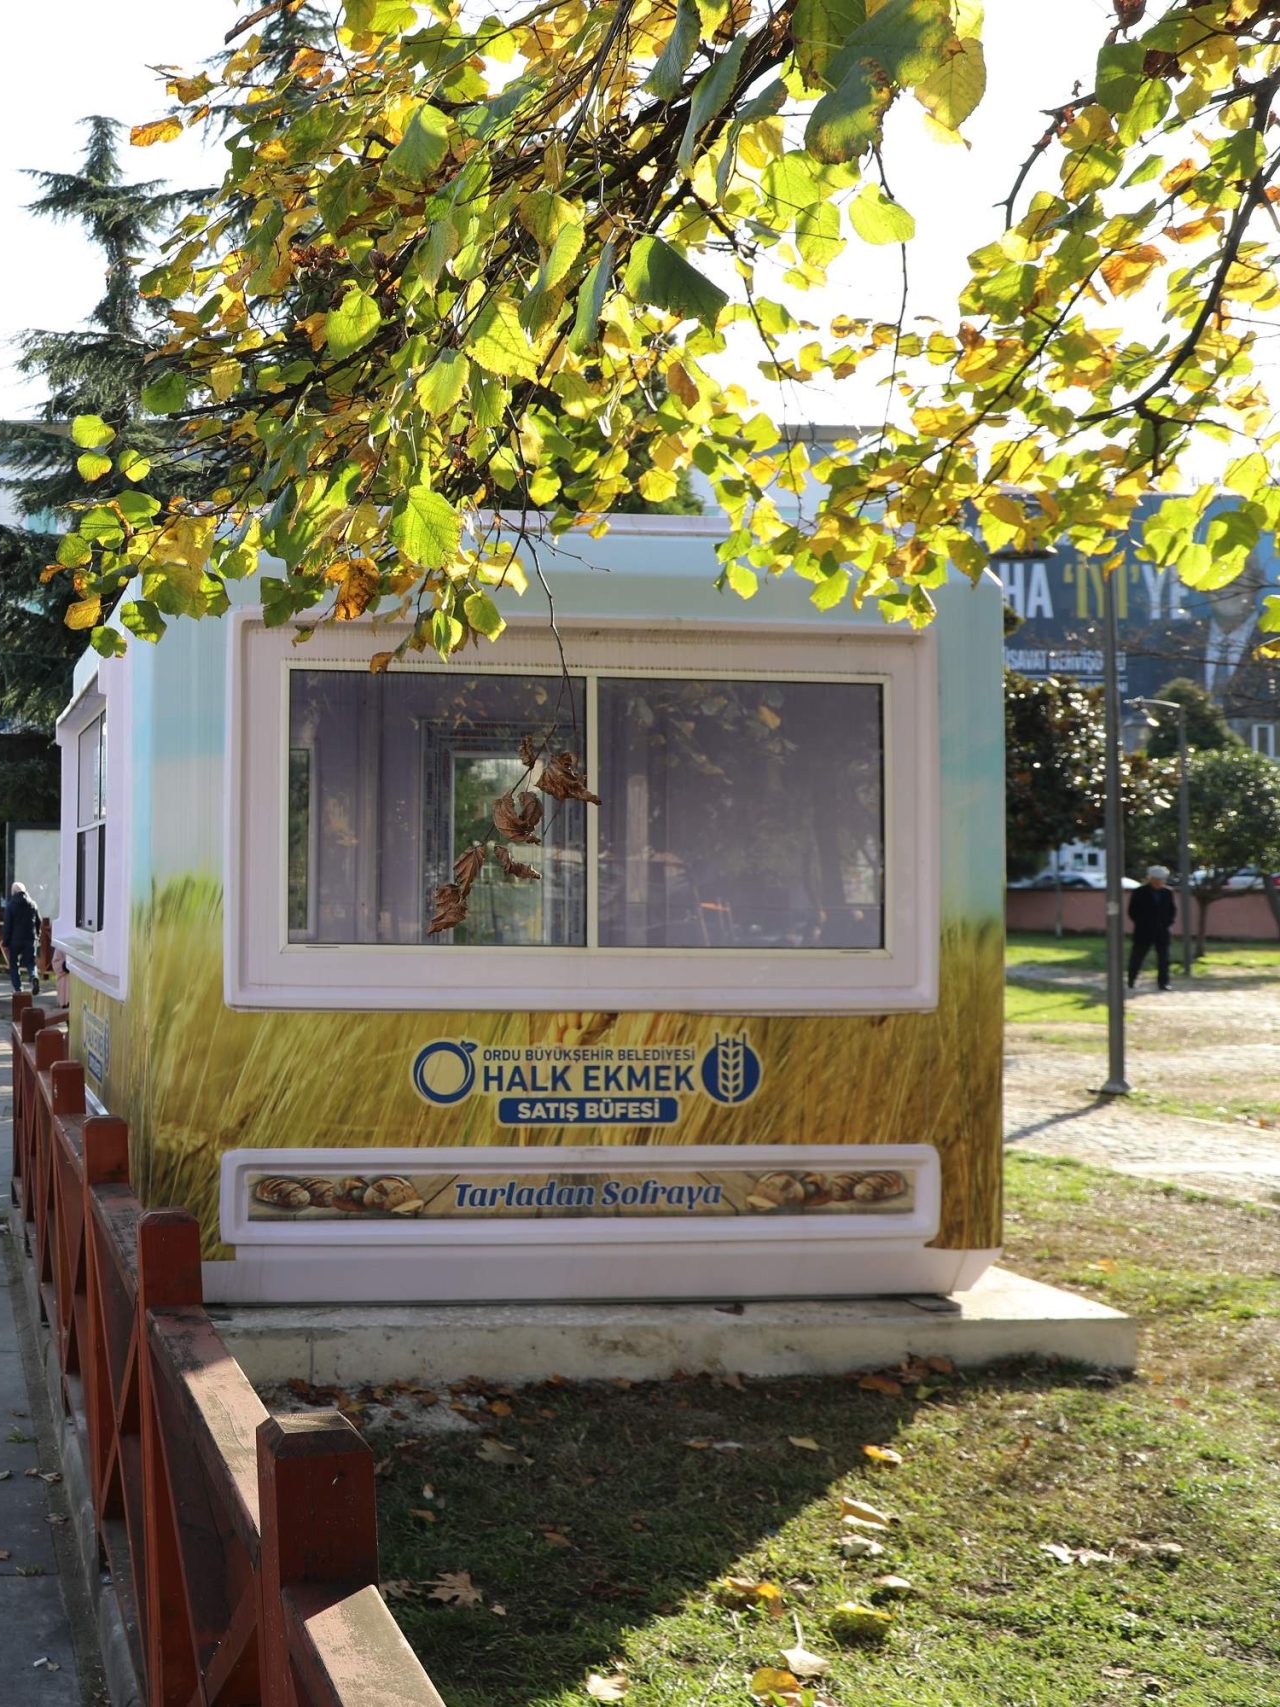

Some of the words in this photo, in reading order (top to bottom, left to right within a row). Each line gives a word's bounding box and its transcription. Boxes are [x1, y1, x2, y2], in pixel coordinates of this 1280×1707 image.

[483, 1050, 520, 1061] ORDU
[525, 1046, 613, 1064] BÜYÜKŞEHİR
[618, 1046, 695, 1061] BELEDİYESİ
[483, 1065, 572, 1092] HALK
[584, 1065, 695, 1092] EKMEK
[517, 1102, 577, 1122] SATIŞ
[584, 1099, 660, 1119] BÜFESİ
[455, 1181, 595, 1207] Tarladan
[601, 1180, 721, 1210] Sofraya
